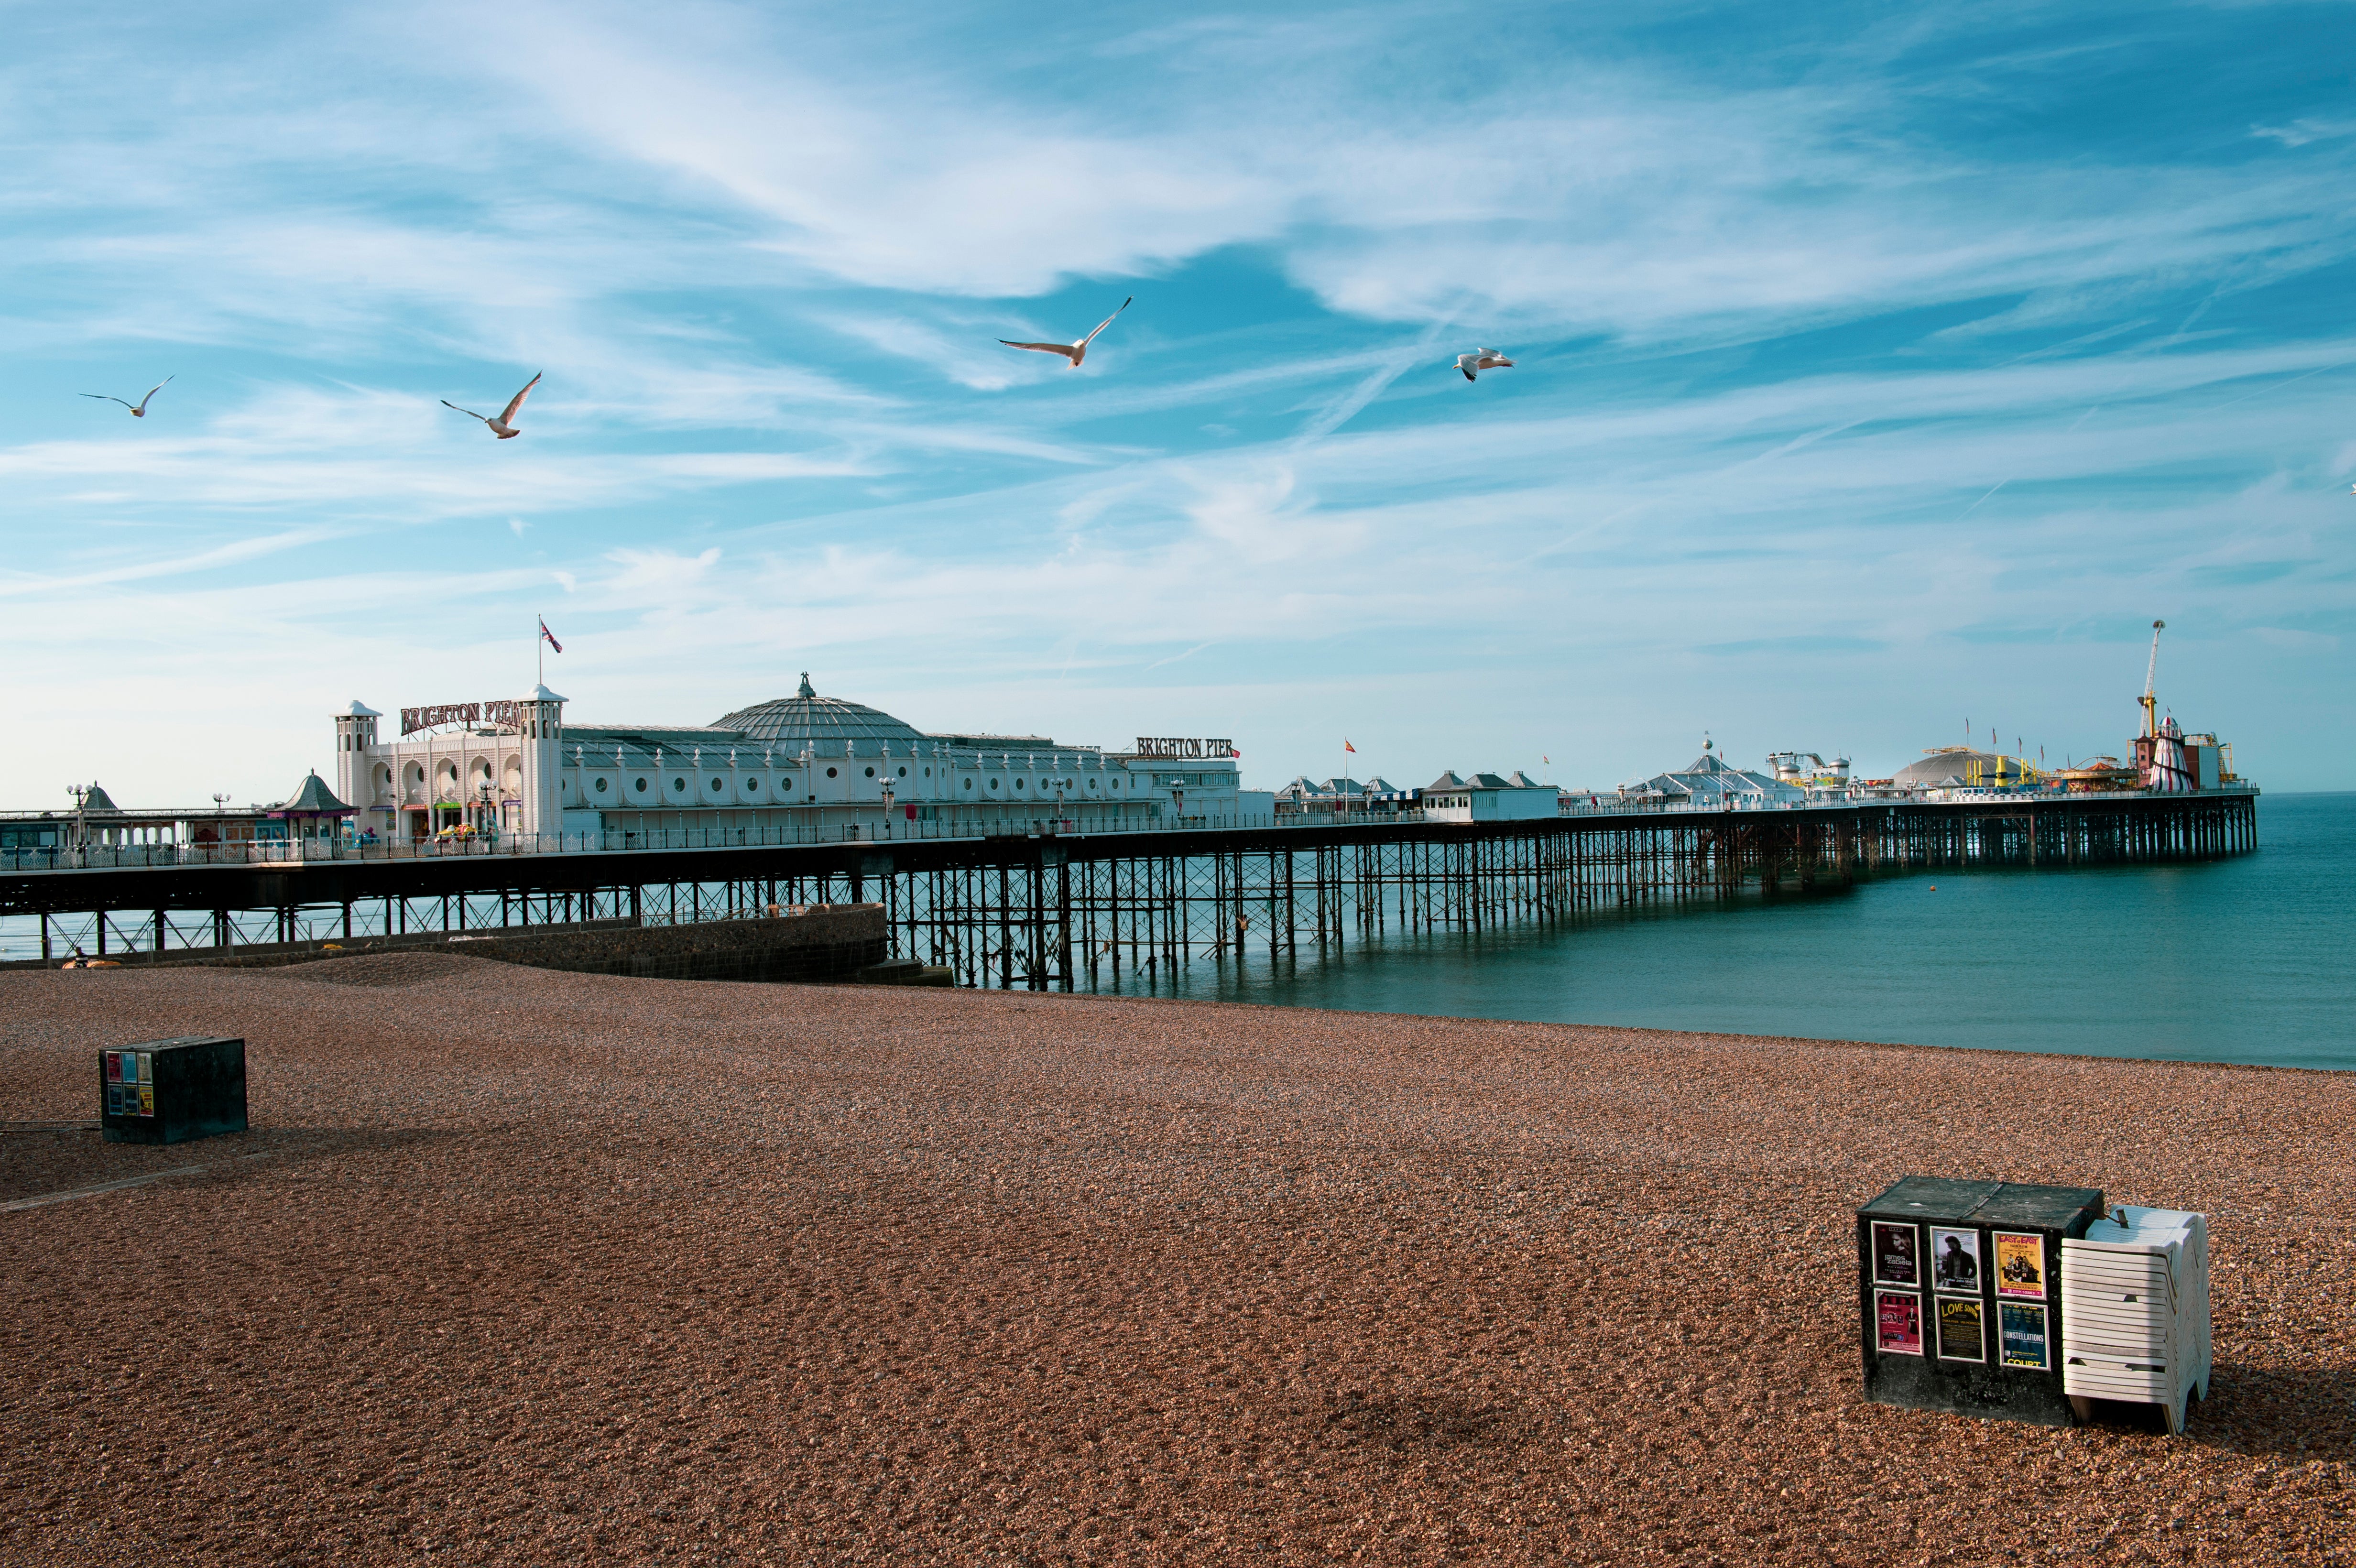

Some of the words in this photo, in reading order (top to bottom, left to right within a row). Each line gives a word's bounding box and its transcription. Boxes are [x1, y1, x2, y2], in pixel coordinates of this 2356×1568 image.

[401, 703, 480, 736] BRIGHTON
[485, 700, 520, 728] PIER
[1137, 737, 1201, 757] BRIGHTON
[1206, 739, 1233, 757] PIER
[2021, 1237, 2038, 1245] EAST
[1942, 1303, 1963, 1318] LOVE
[2003, 1331, 2044, 1342] CONSTELLATIONS
[2007, 1358, 2041, 1367] COURT
